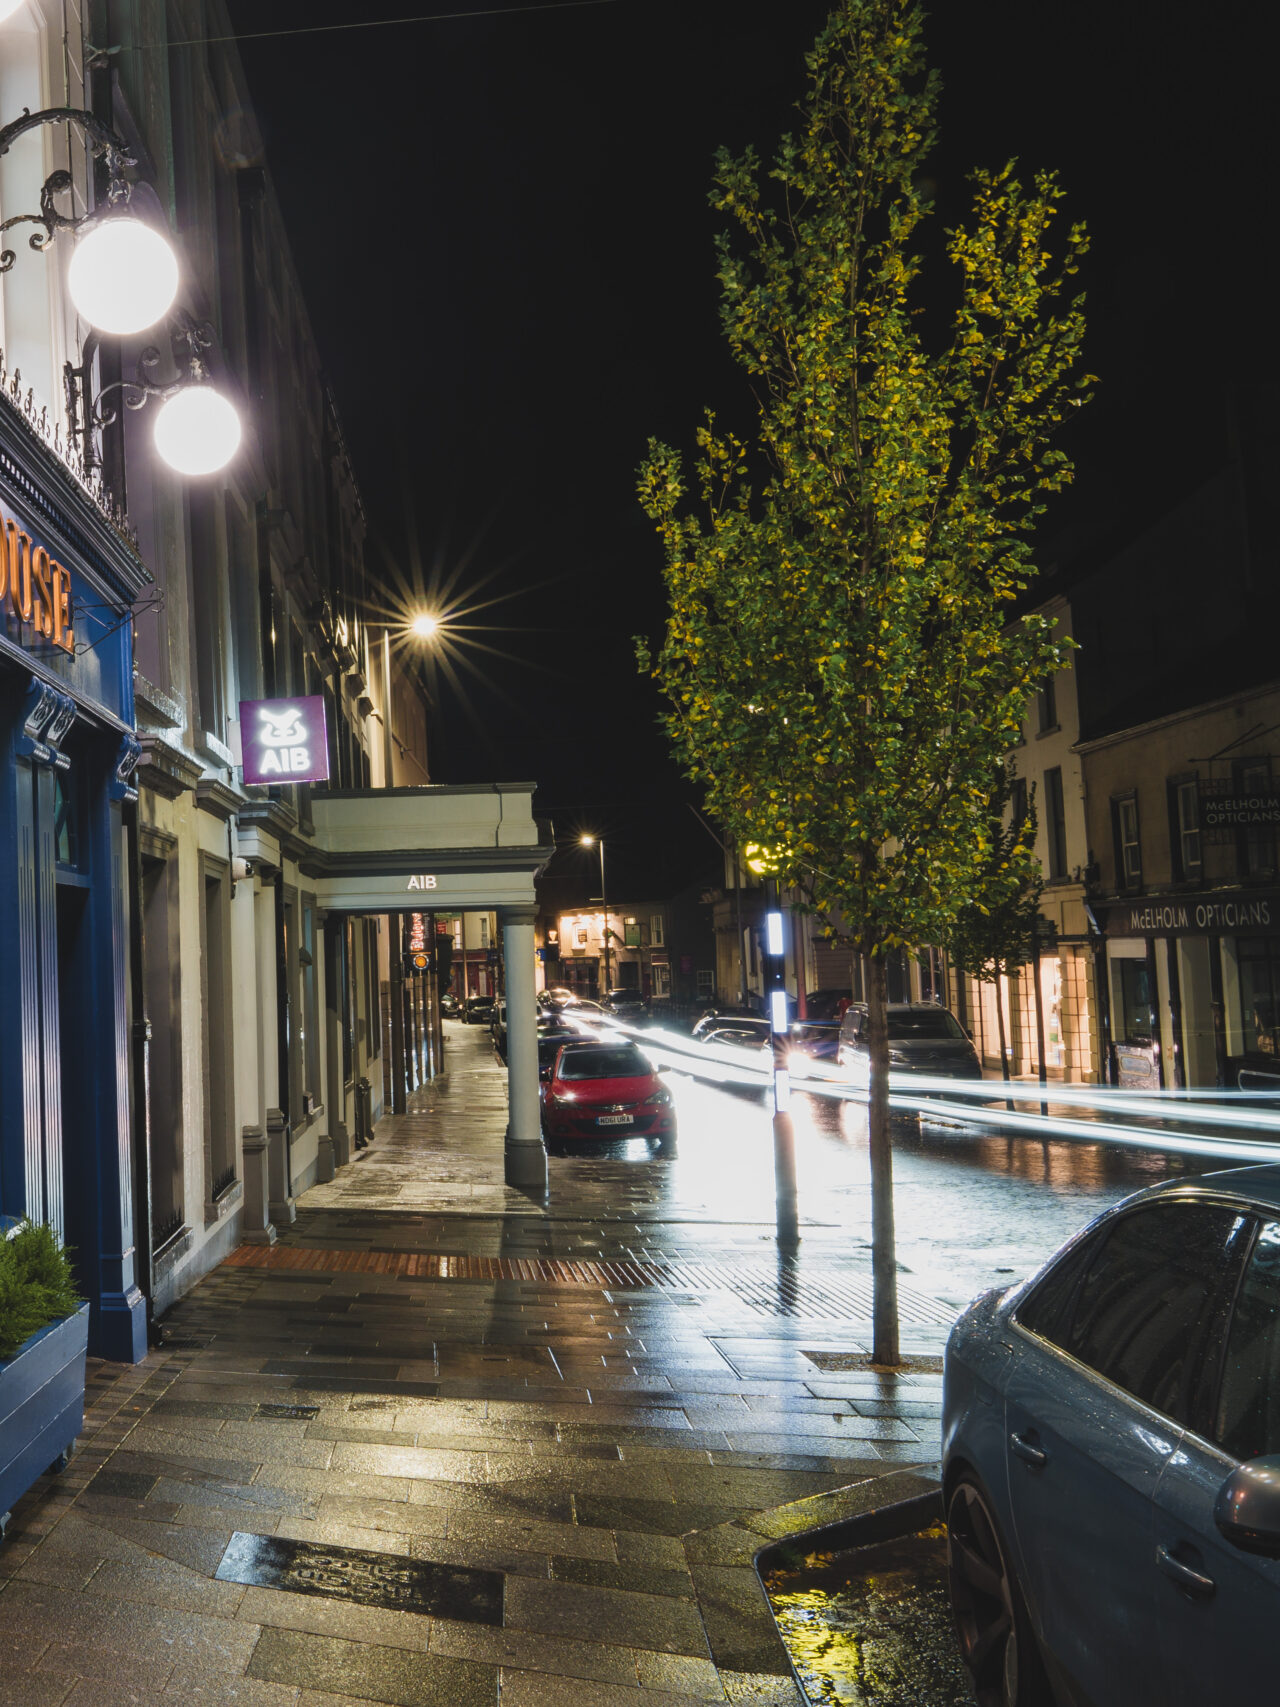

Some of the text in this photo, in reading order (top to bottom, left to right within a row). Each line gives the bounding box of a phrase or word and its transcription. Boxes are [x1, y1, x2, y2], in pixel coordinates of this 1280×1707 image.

[258, 746, 311, 775] AIB
[1206, 798, 1280, 811] McELHOLM
[1206, 810, 1280, 824] OPTICIANS
[407, 875, 437, 889] AIB
[1131, 902, 1271, 929] McELHOLM OPTICIANS
